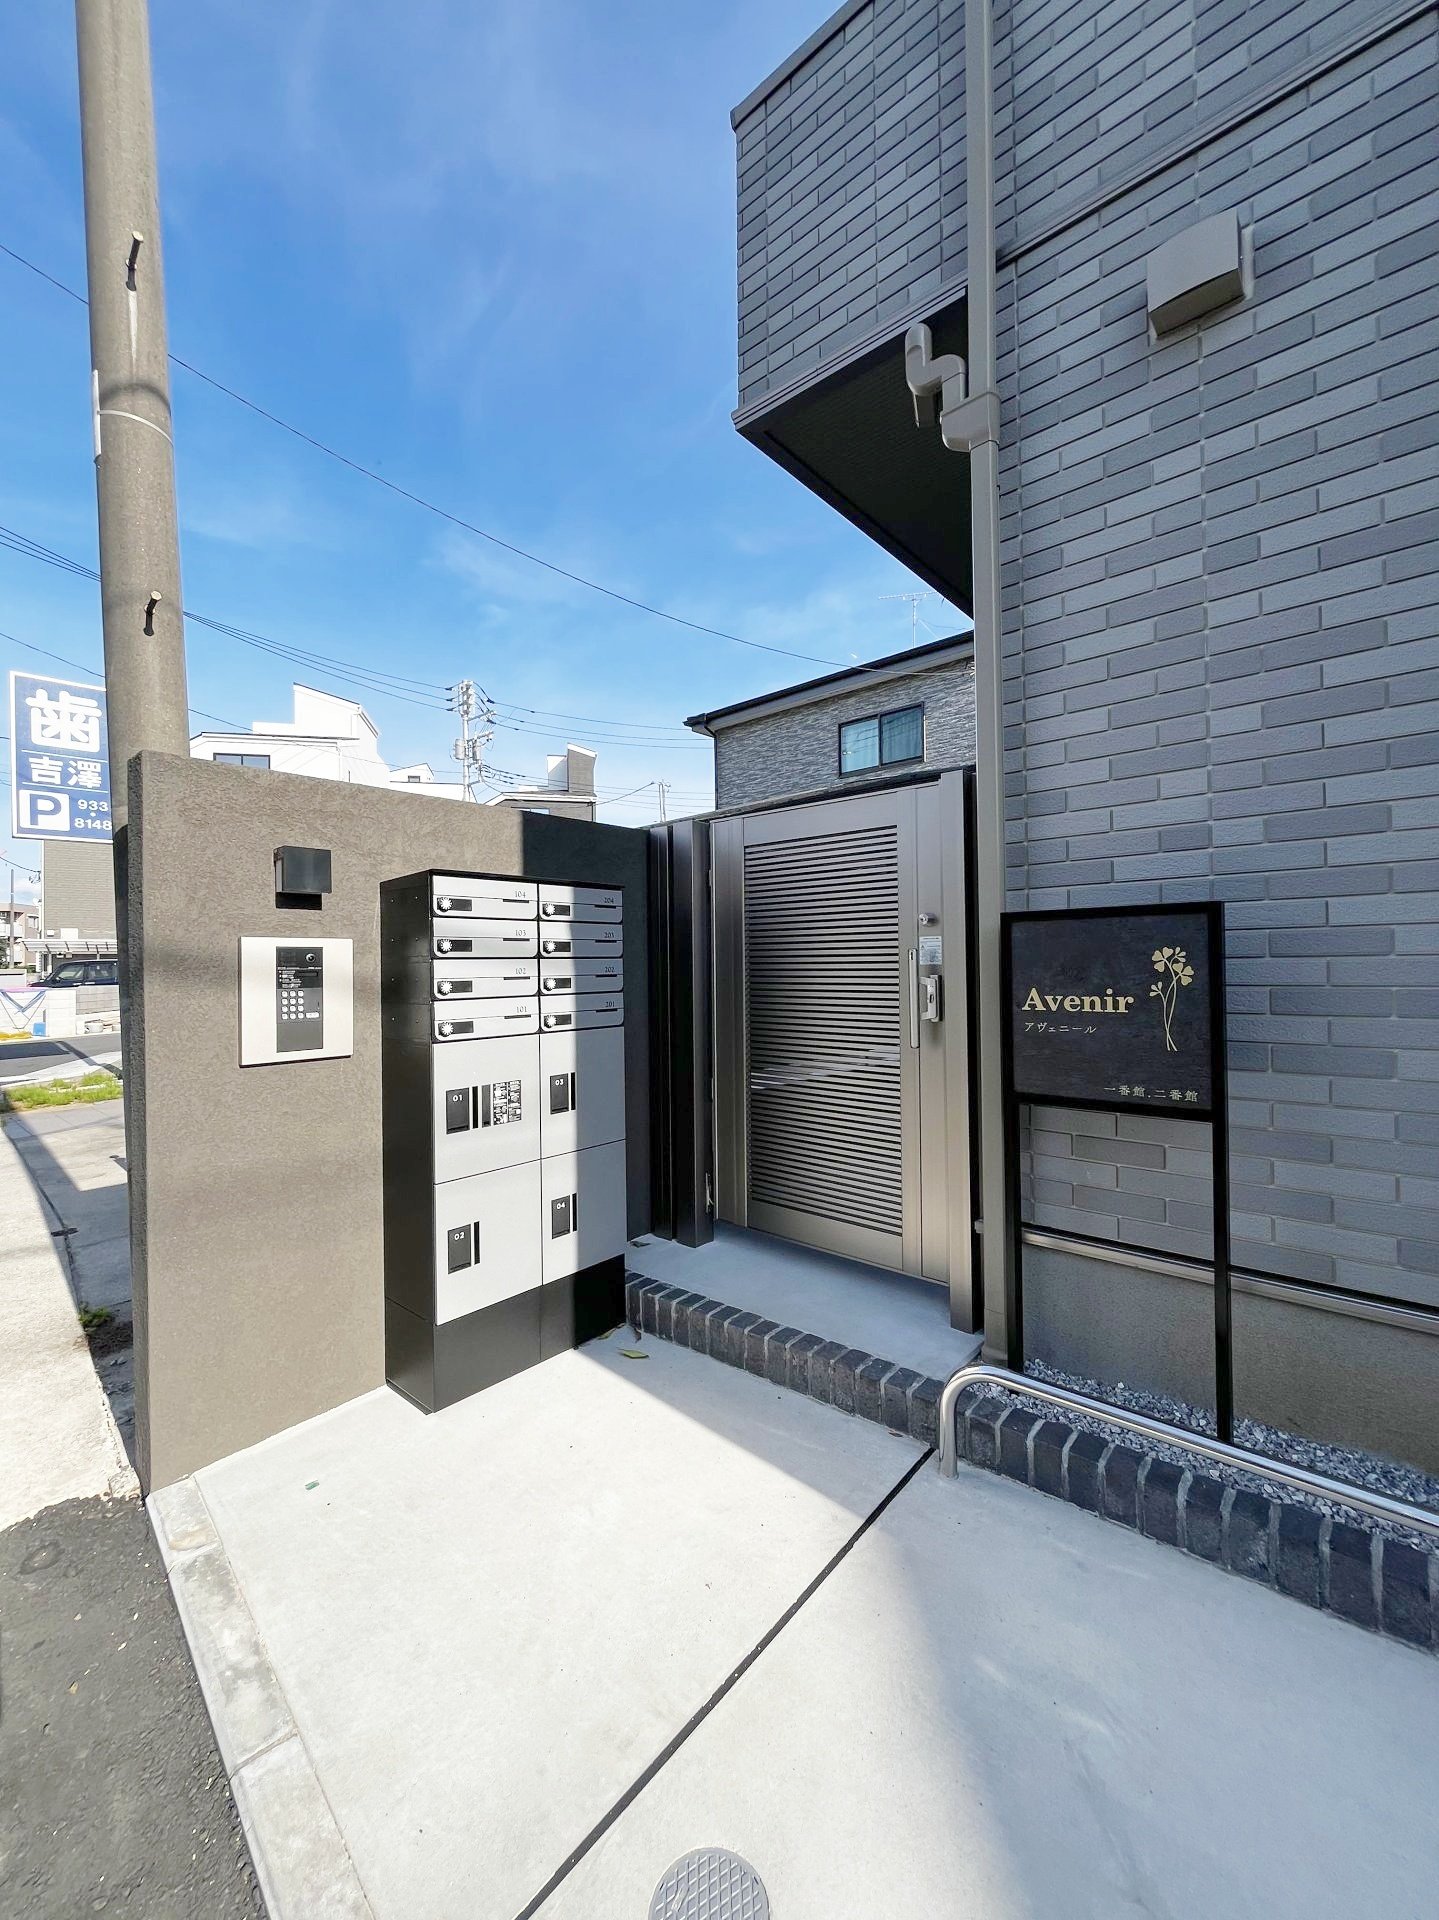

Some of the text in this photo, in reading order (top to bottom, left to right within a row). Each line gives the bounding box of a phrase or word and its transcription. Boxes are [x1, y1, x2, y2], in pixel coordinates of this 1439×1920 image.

[25, 688, 102, 752] 歯
[29, 756, 102, 788] 吉澤
[30, 794, 62, 825] P
[77, 799, 109, 812] 933
[74, 817, 112, 831] 8148
[514, 890, 526, 899] 104
[515, 929, 527, 937] 103
[515, 967, 527, 975] 102
[1022, 987, 1134, 1013] Avenir
[1024, 1022, 1096, 1033] アヴェニール
[555, 1078, 564, 1086] 03
[452, 1094, 463, 1102] 01
[556, 1202, 566, 1210] 04
[454, 1232, 464, 1240] 02
